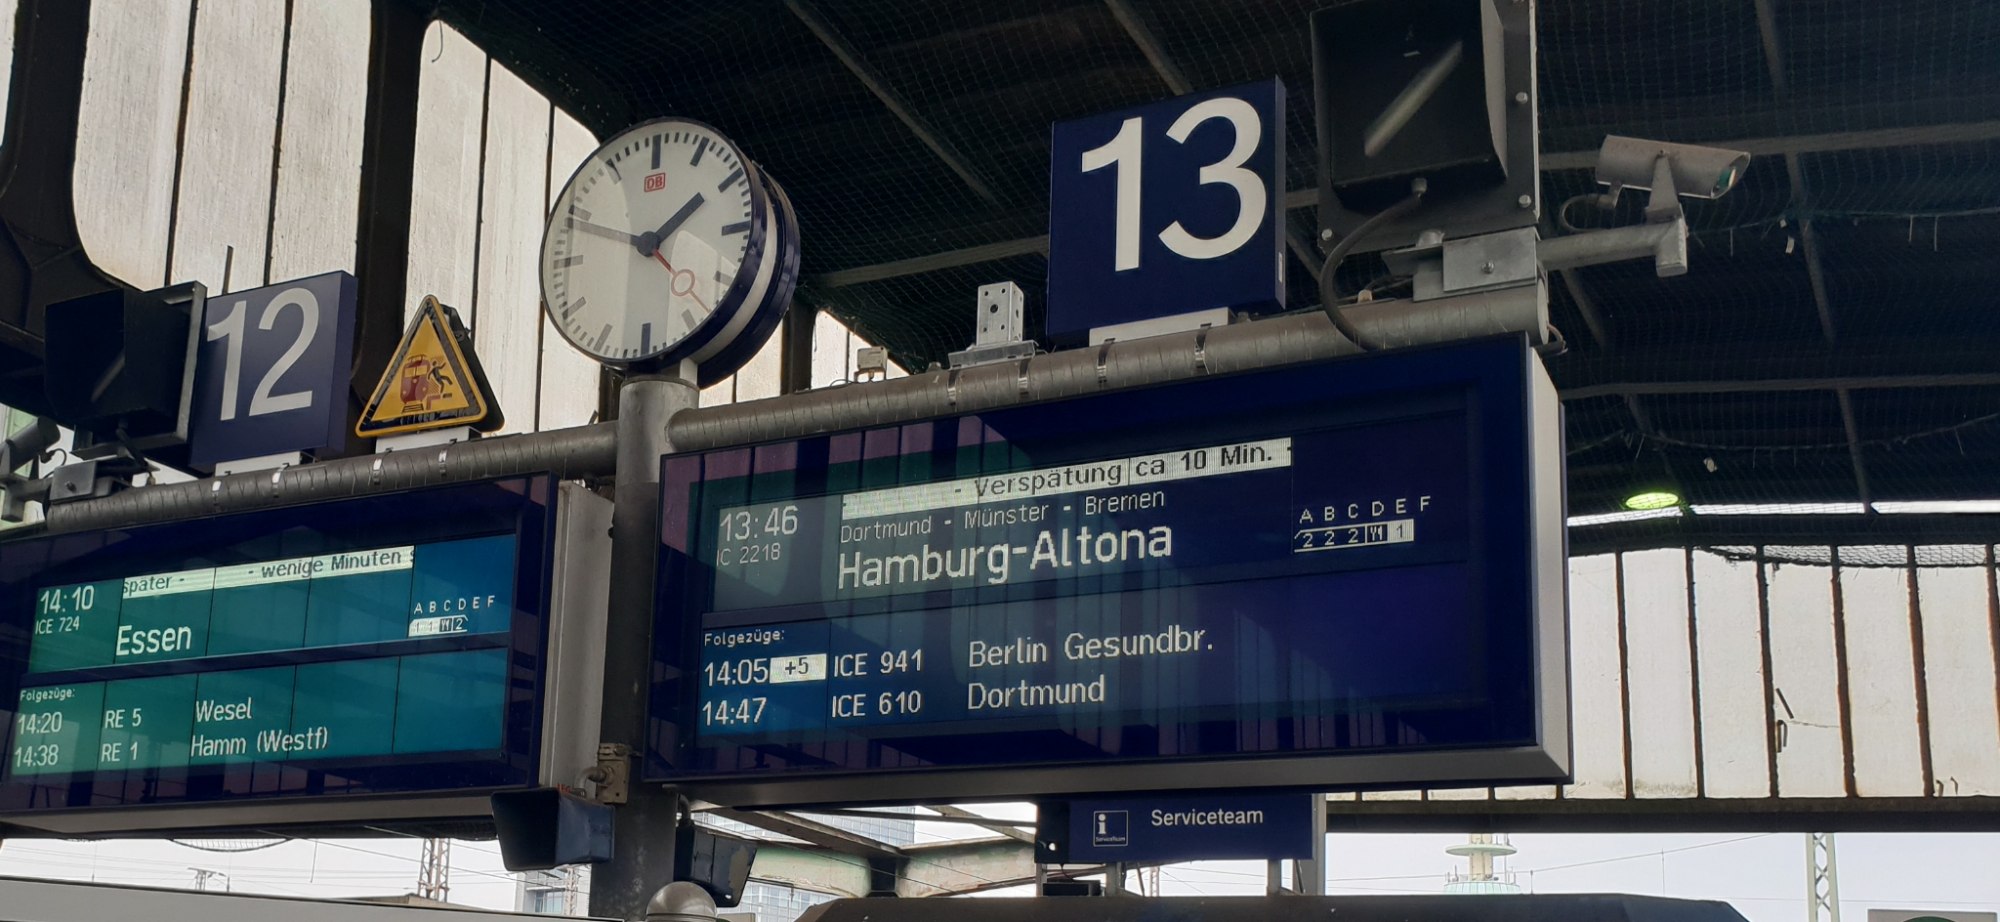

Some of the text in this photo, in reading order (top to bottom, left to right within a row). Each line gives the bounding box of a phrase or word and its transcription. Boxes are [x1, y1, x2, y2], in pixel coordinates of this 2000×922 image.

[646, 175, 663, 189] DB
[1081, 97, 1266, 272] 13
[206, 287, 319, 421] 12
[974, 462, 1122, 497] Verspätung
[1136, 458, 1165, 477] ca
[1180, 449, 1207, 471] 10
[1220, 444, 1272, 467] Min.
[720, 505, 798, 542] 13:46
[840, 515, 932, 544] Dortmund
[964, 504, 1049, 529] Münster
[1085, 490, 1165, 516] Bremen
[1299, 495, 1431, 524] A B C D E F
[1302, 524, 1403, 548] 2 2 2 1
[261, 559, 324, 578] wenige
[331, 549, 400, 572] Minuten
[716, 542, 781, 566] IC 2218
[838, 525, 1172, 590] Hamburg-Altona
[40, 585, 95, 614] 14:10
[413, 595, 495, 615] A B C D E F
[35, 616, 80, 635] ICE 724
[456, 618, 463, 630] 2
[704, 629, 785, 648] Folgezüge:
[116, 625, 192, 657] Essen
[704, 624, 1214, 687] 14:05 +5 ICE 941 Berlin Gesundbr.
[20, 687, 76, 703] Folgezüge:
[702, 673, 1105, 727] 14:47 ICE 610 Dortmund
[18, 697, 252, 735] 14:20 RE 5 Wesel
[14, 726, 329, 768] 14:38 RE 1 Hamm (Westf)
[1150, 808, 1264, 827] Serviceteam
